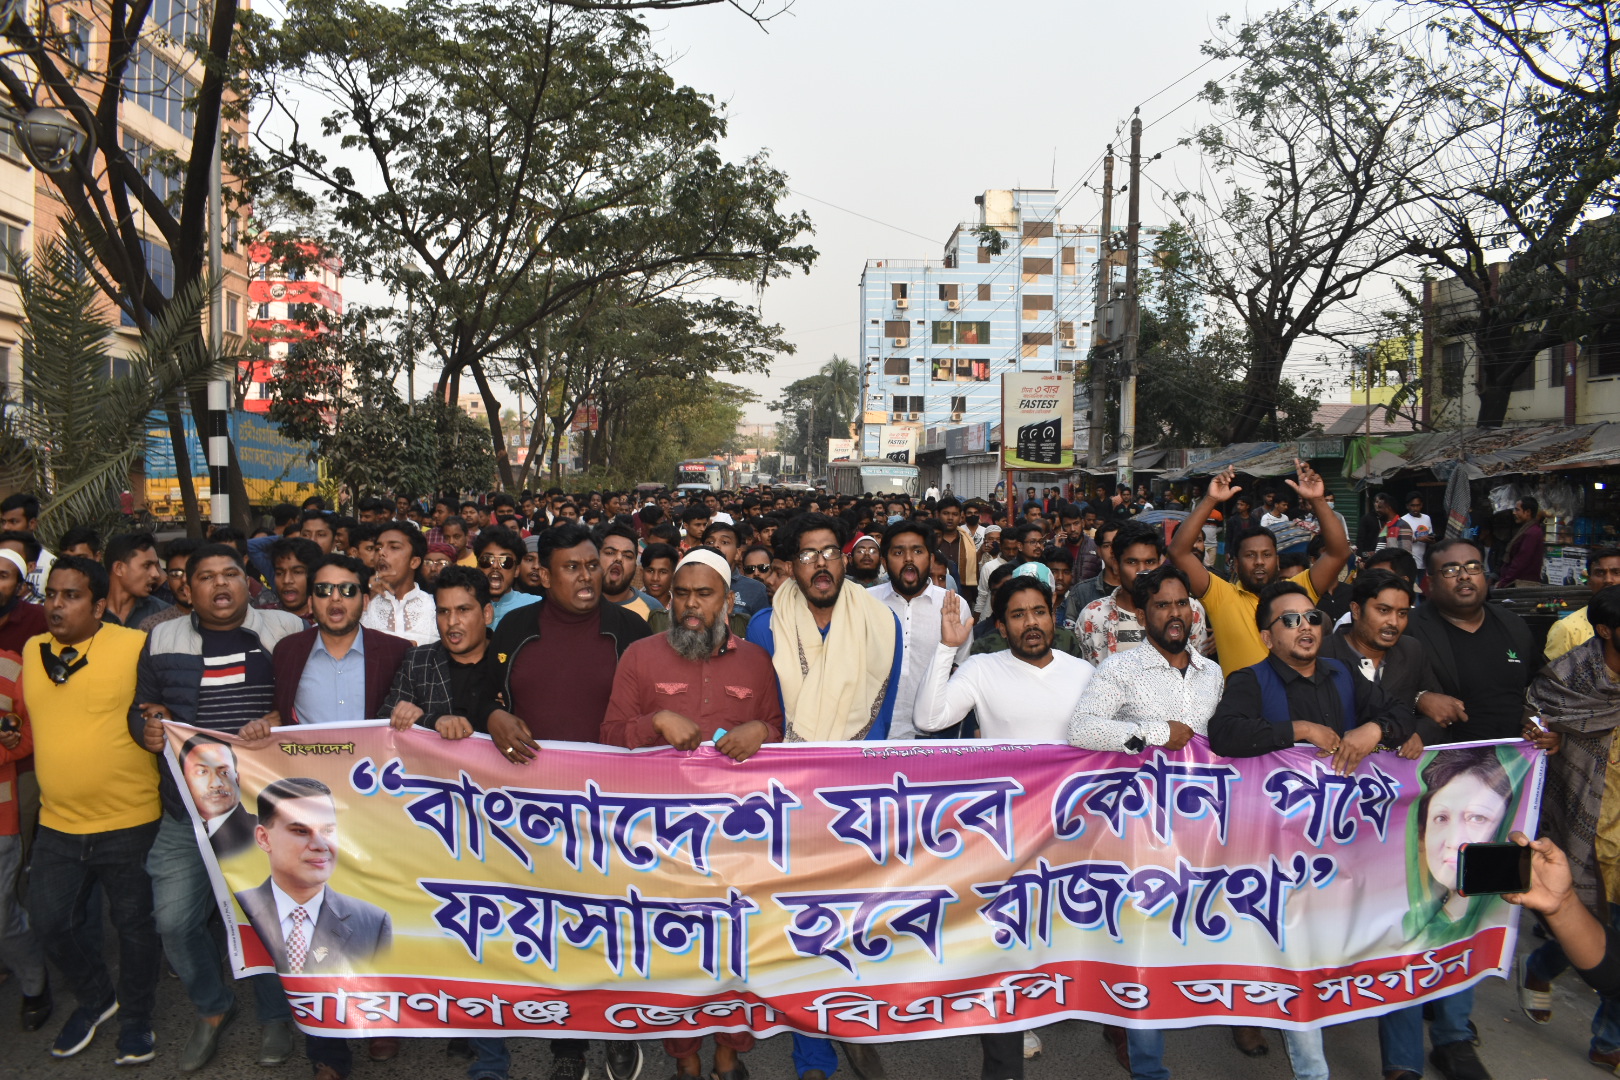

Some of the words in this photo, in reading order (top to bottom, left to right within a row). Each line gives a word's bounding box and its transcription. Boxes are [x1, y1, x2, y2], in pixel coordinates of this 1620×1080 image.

[1018, 399, 1060, 409] FASTEST
[279, 741, 355, 756] বাংলাদেশ
[814, 772, 1025, 866] যাবে
[1051, 749, 1241, 845] কোন
[1265, 760, 1401, 847] পথে
[418, 878, 758, 980] ফয়সালা
[772, 885, 958, 979] হবে
[284, 987, 571, 1025] রায়ণগঞ্জ
[604, 999, 786, 1029] জেলা
[803, 972, 1073, 1033] বিএনপি
[1100, 979, 1149, 1009] ও
[1172, 978, 1302, 1015] অঙ্গ
[1313, 948, 1473, 1006] সংগঠন
